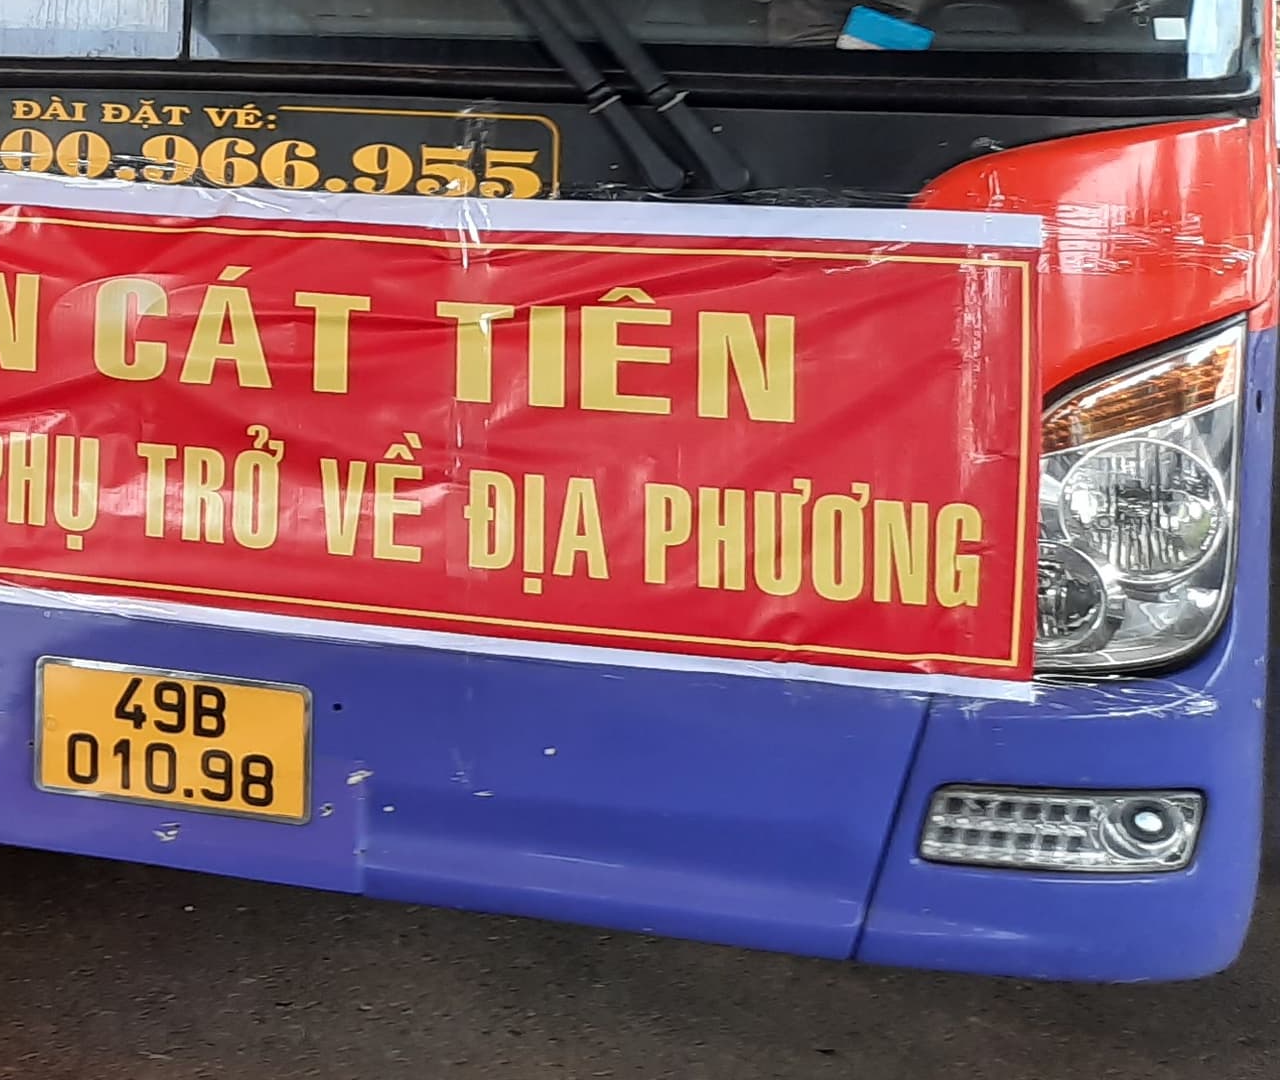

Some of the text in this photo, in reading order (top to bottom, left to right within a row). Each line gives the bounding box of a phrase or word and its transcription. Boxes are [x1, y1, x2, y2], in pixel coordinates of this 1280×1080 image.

[12, 96, 88, 122] ĐÀI
[100, 99, 191, 129] ĐẶT
[203, 104, 278, 130] VÉ:
[92, 265, 372, 394] CÁT
[436, 286, 796, 424] TIÊN
[135, 424, 286, 549] TRỞ
[319, 431, 424, 563] VỀ
[463, 468, 611, 596] ĐỊA
[644, 476, 983, 609] PHƯƠNG
[114, 677, 226, 739] 49B
[66, 731, 274, 808] 010.98
